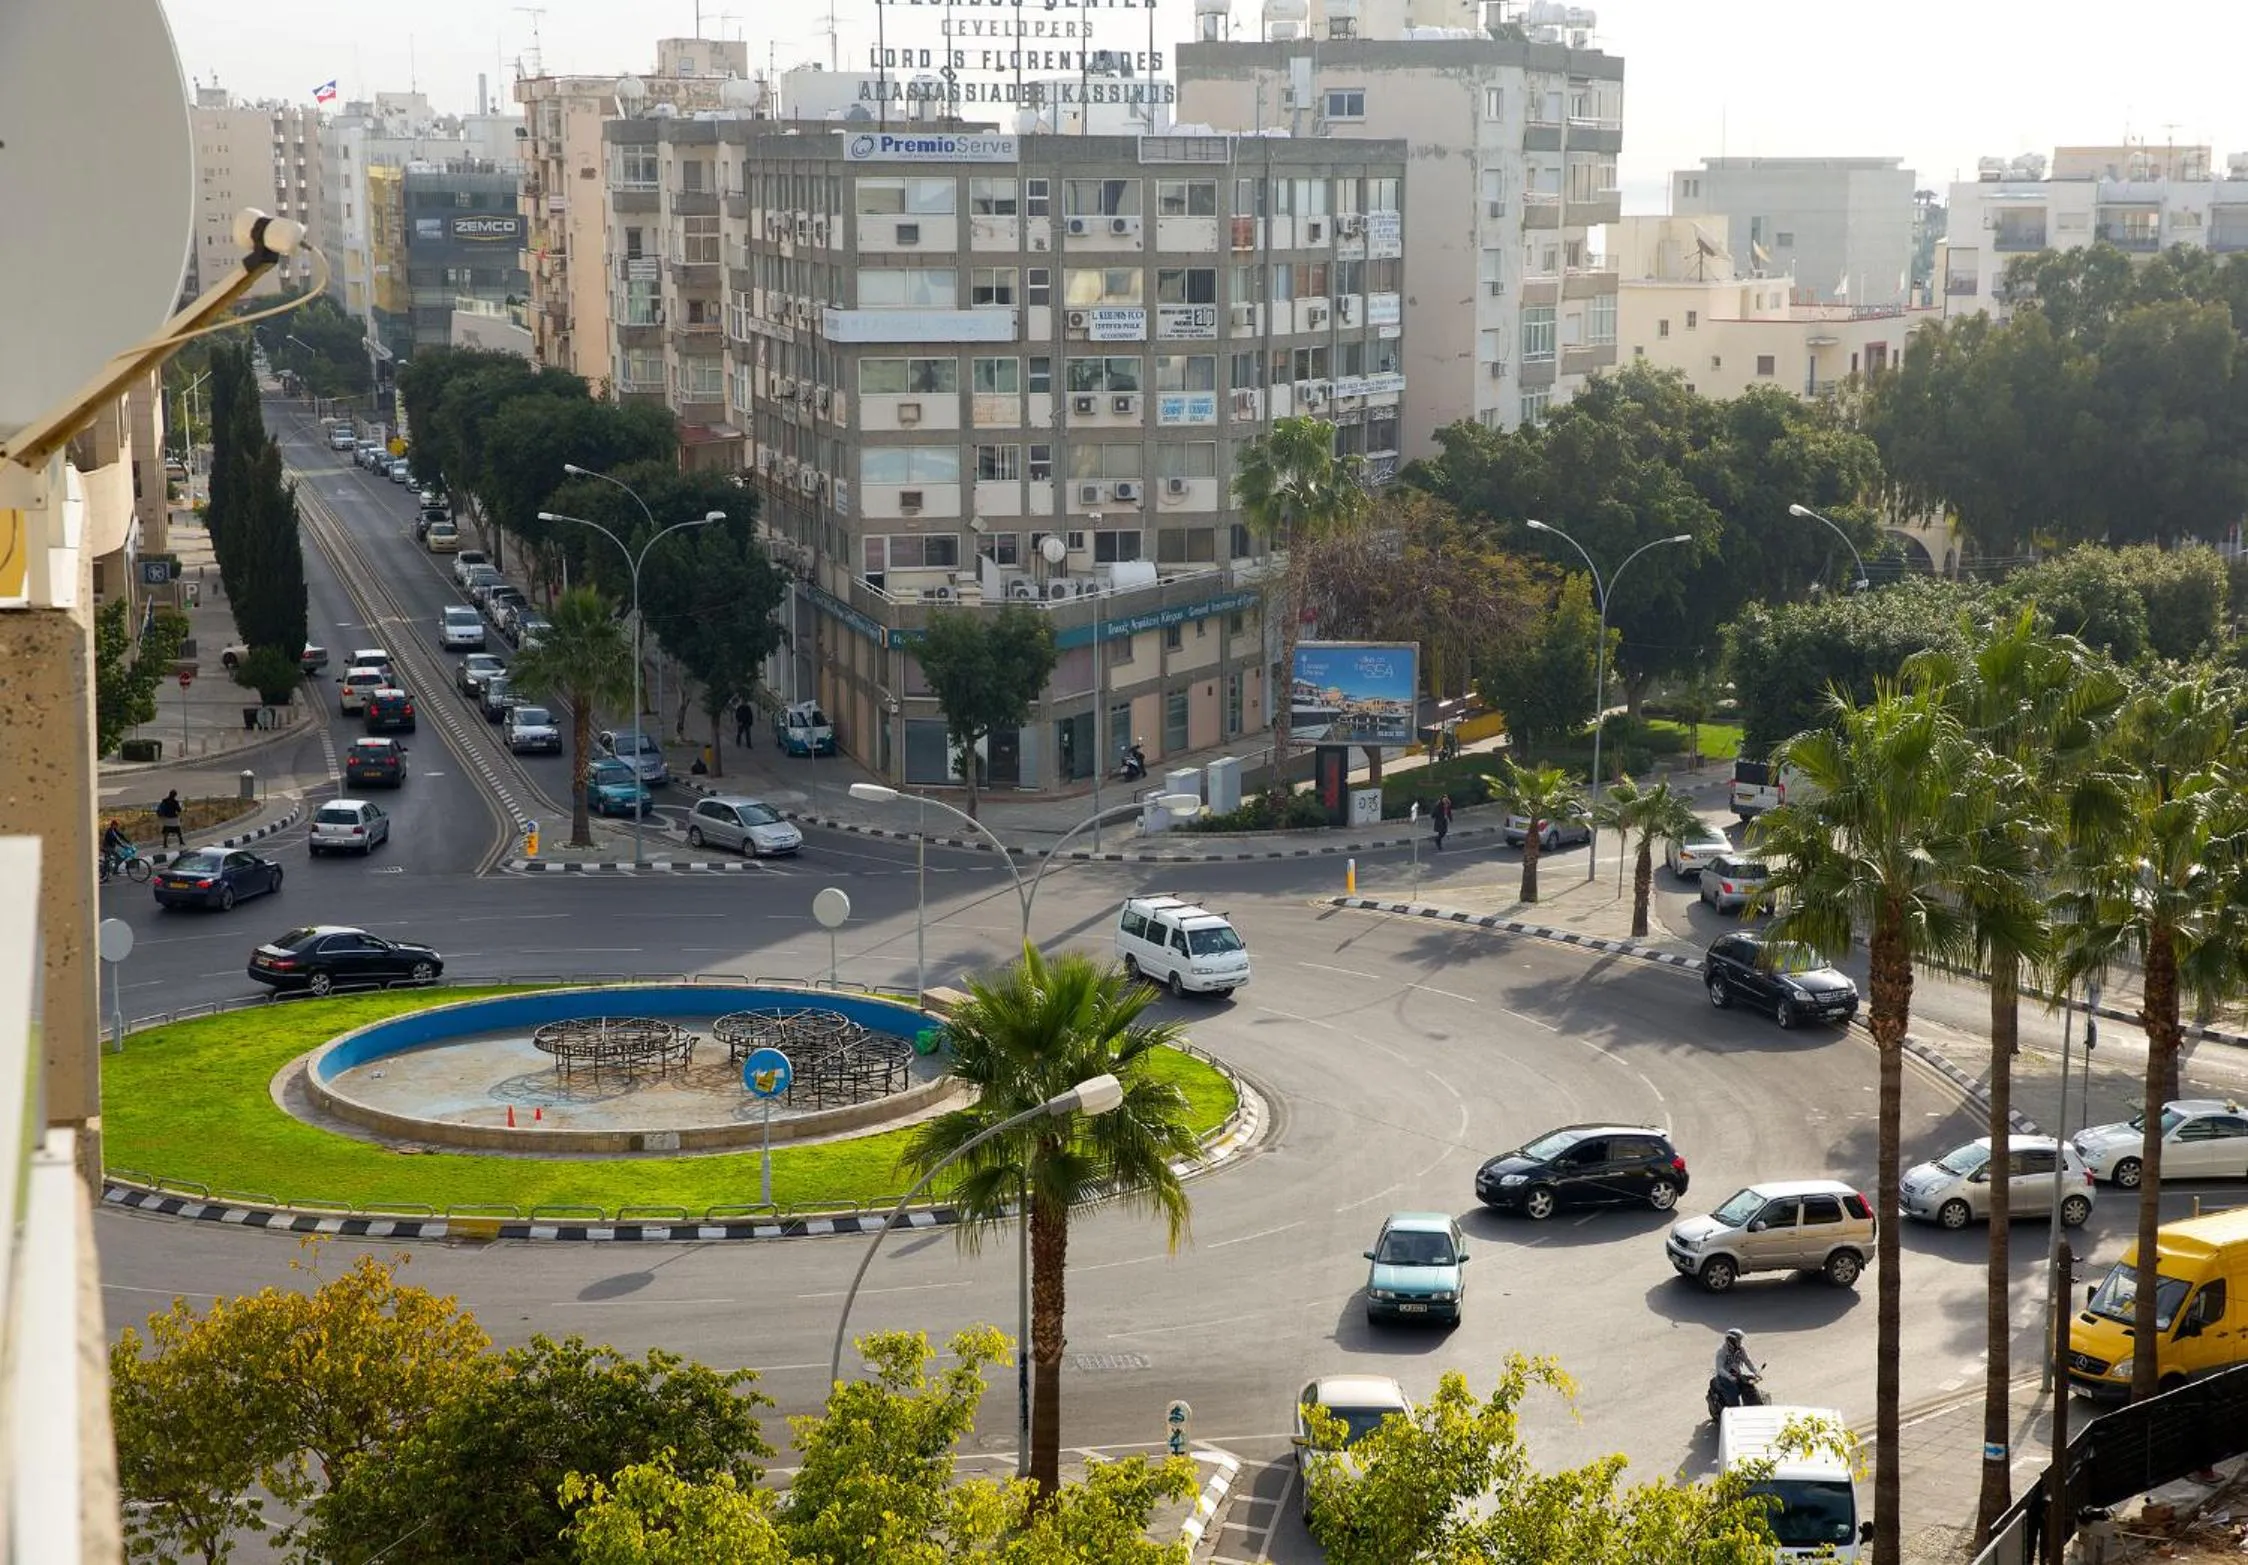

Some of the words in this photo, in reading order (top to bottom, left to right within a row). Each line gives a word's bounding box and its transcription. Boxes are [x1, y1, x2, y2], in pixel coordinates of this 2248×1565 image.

[941, 19, 1093, 38] DEVELOPERS
[880, 136, 1013, 154] PremioServe
[455, 221, 517, 233] ZEMCO
[186, 584, 198, 600] P
